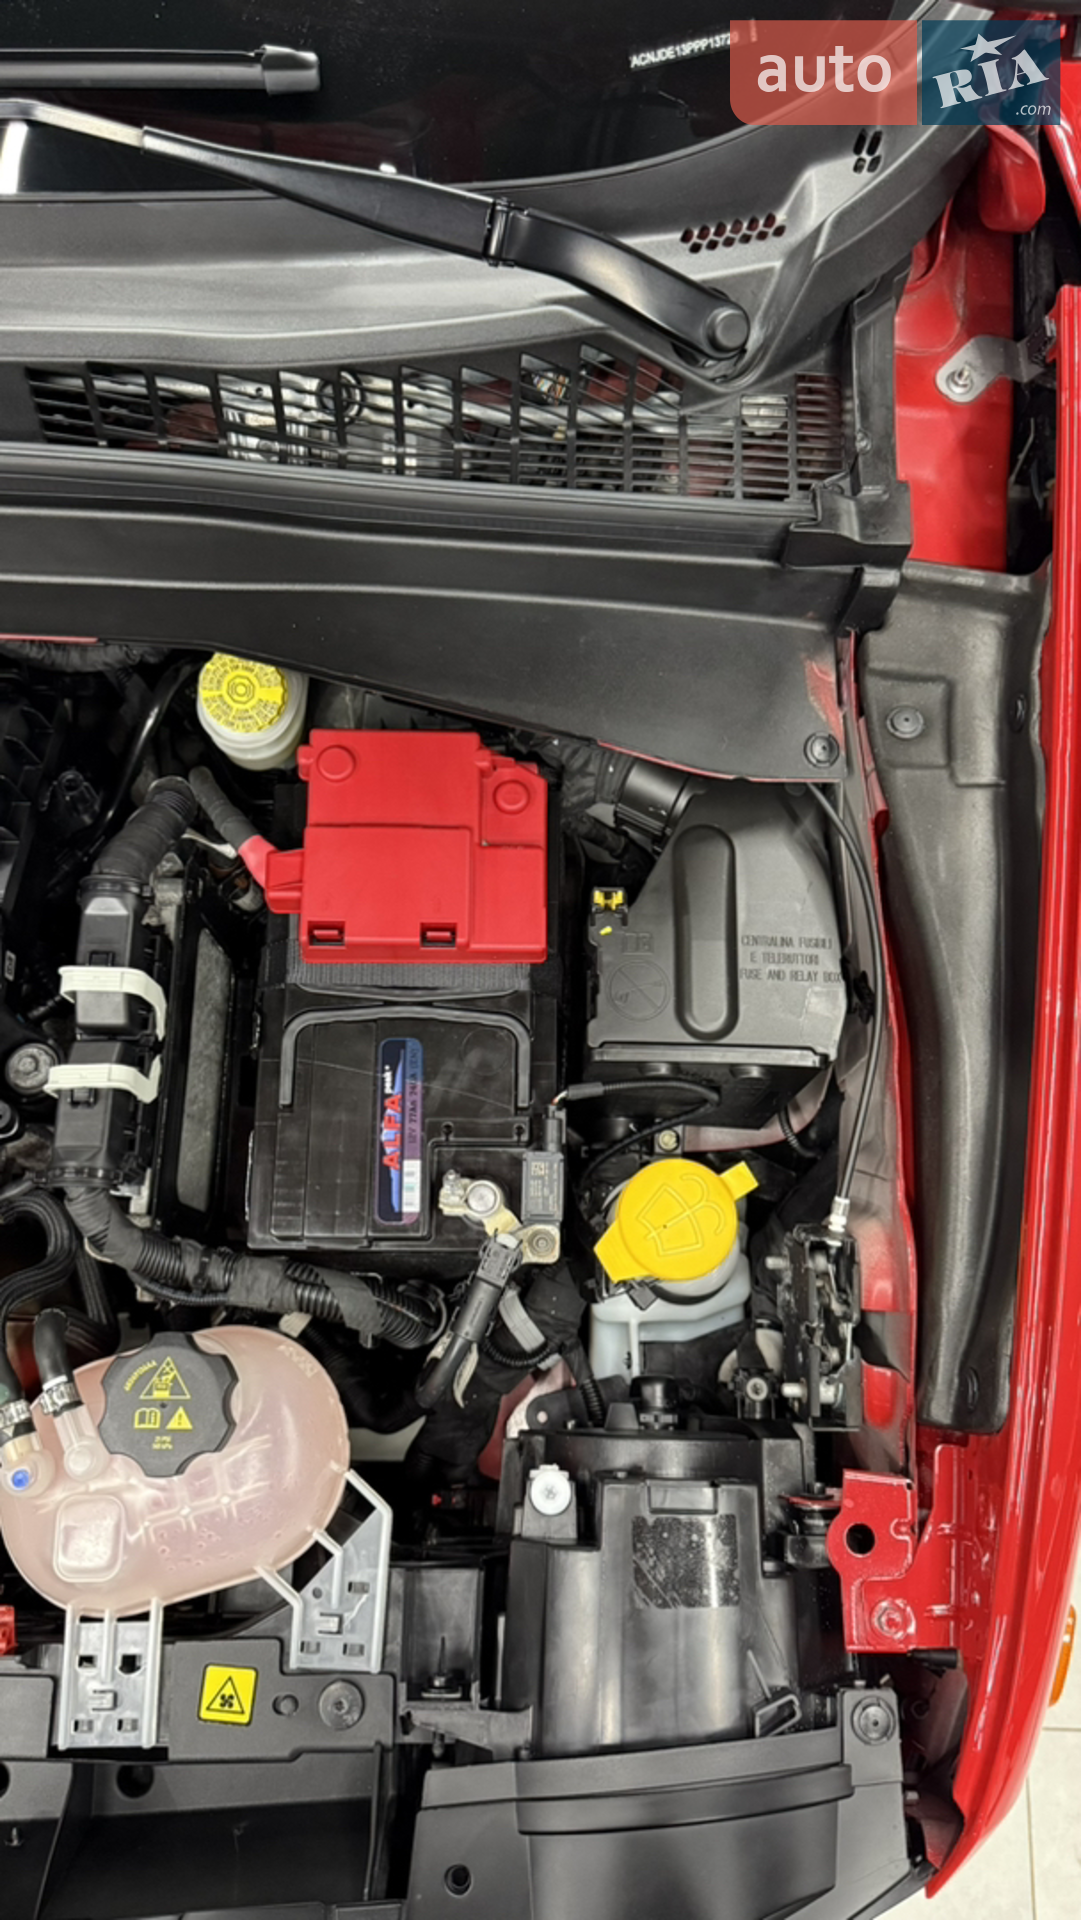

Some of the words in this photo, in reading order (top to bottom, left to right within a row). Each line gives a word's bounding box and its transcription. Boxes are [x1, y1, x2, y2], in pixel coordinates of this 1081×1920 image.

[741, 935, 795, 949] CENTRALINA
[750, 952, 757, 963] E
[740, 968, 762, 980] FUSE
[766, 969, 786, 981] AND
[790, 970, 818, 982] RELAY
[823, 971, 842, 983] BOX
[383, 1095, 402, 1170] ALFA
